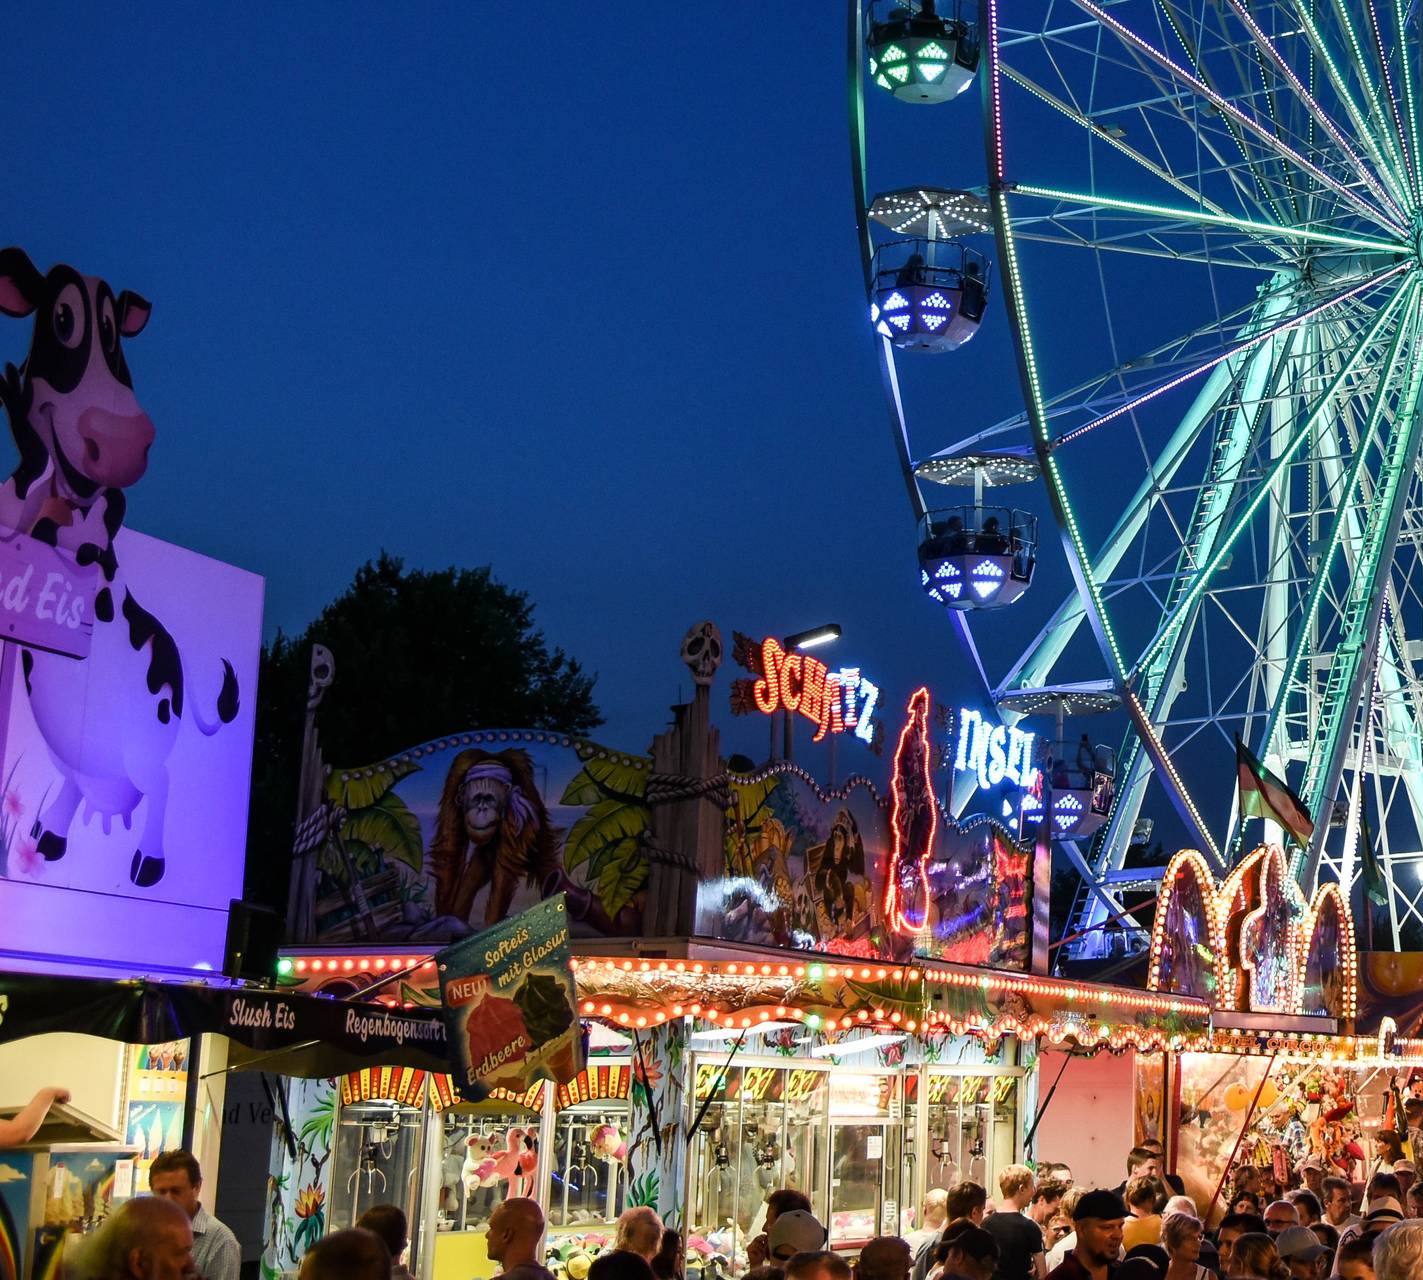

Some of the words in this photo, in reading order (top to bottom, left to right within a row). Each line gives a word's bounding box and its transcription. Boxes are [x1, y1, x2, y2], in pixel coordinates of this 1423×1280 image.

[36, 572, 85, 629] Eis
[754, 637, 879, 743] SCHATZ
[954, 708, 1039, 789] INSEL
[485, 927, 530, 968] Softeis
[497, 961, 522, 988] mit
[522, 927, 568, 969] Glasur
[229, 998, 273, 1028] Slush
[275, 1001, 296, 1030] Eis
[466, 1034, 526, 1086] Erdbeere
